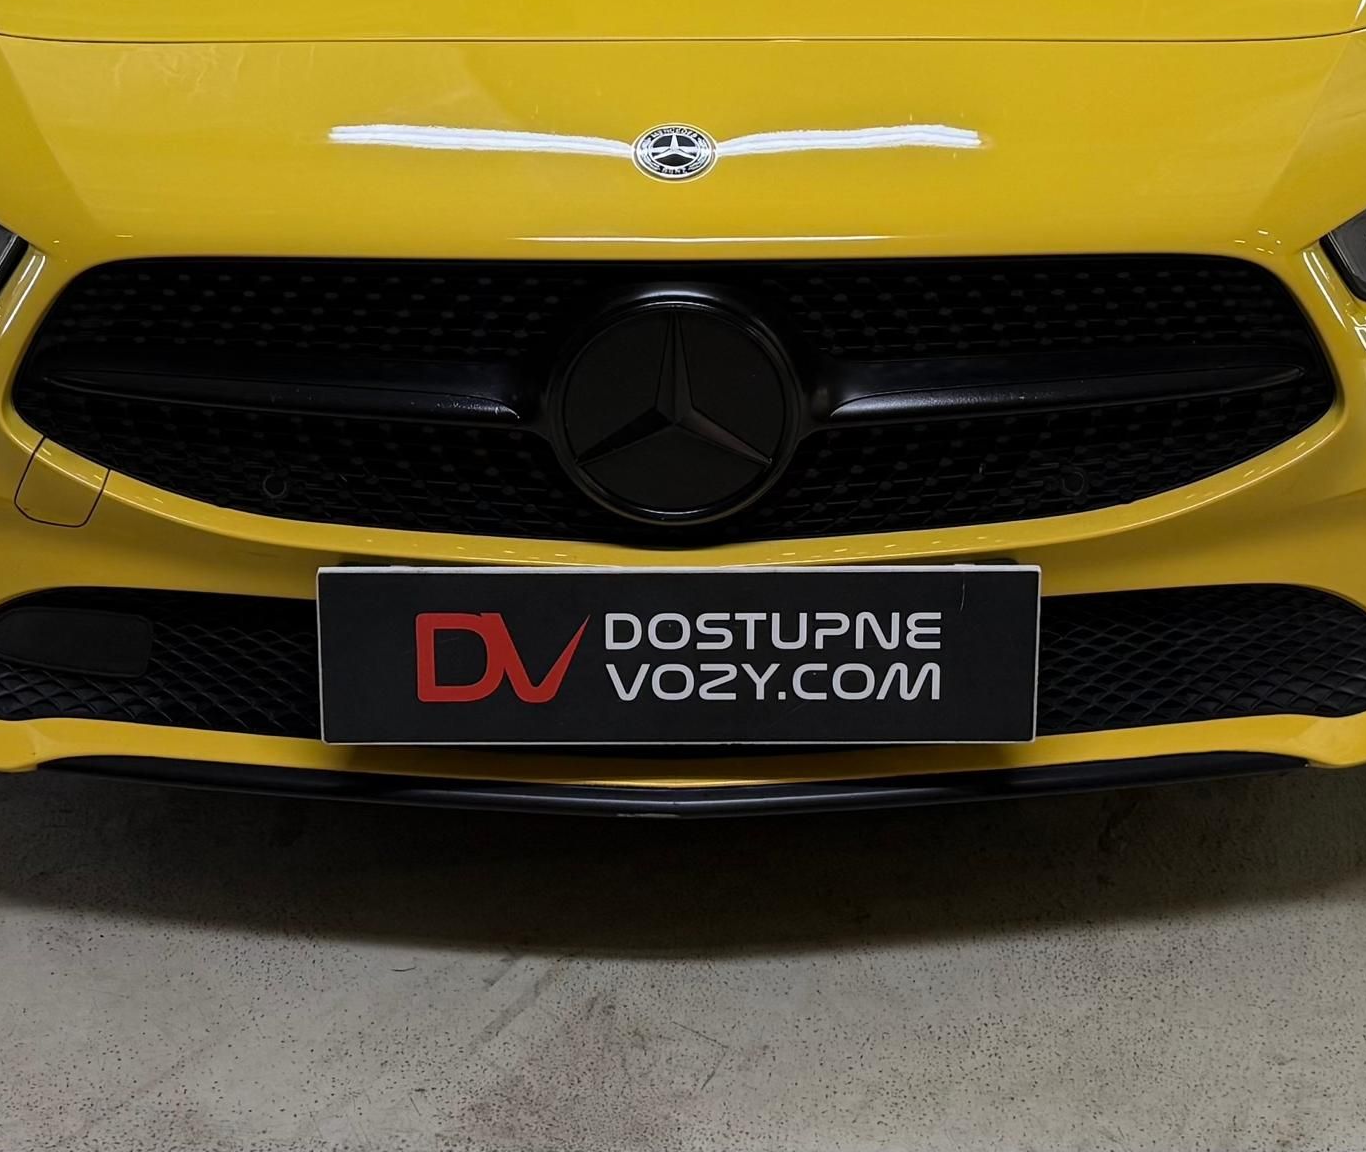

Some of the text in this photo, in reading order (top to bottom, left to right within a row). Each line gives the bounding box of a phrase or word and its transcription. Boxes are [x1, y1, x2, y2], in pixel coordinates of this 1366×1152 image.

[415, 612, 943, 703] DV DOSTUPNE
[606, 663, 942, 701] VOZY.COM
